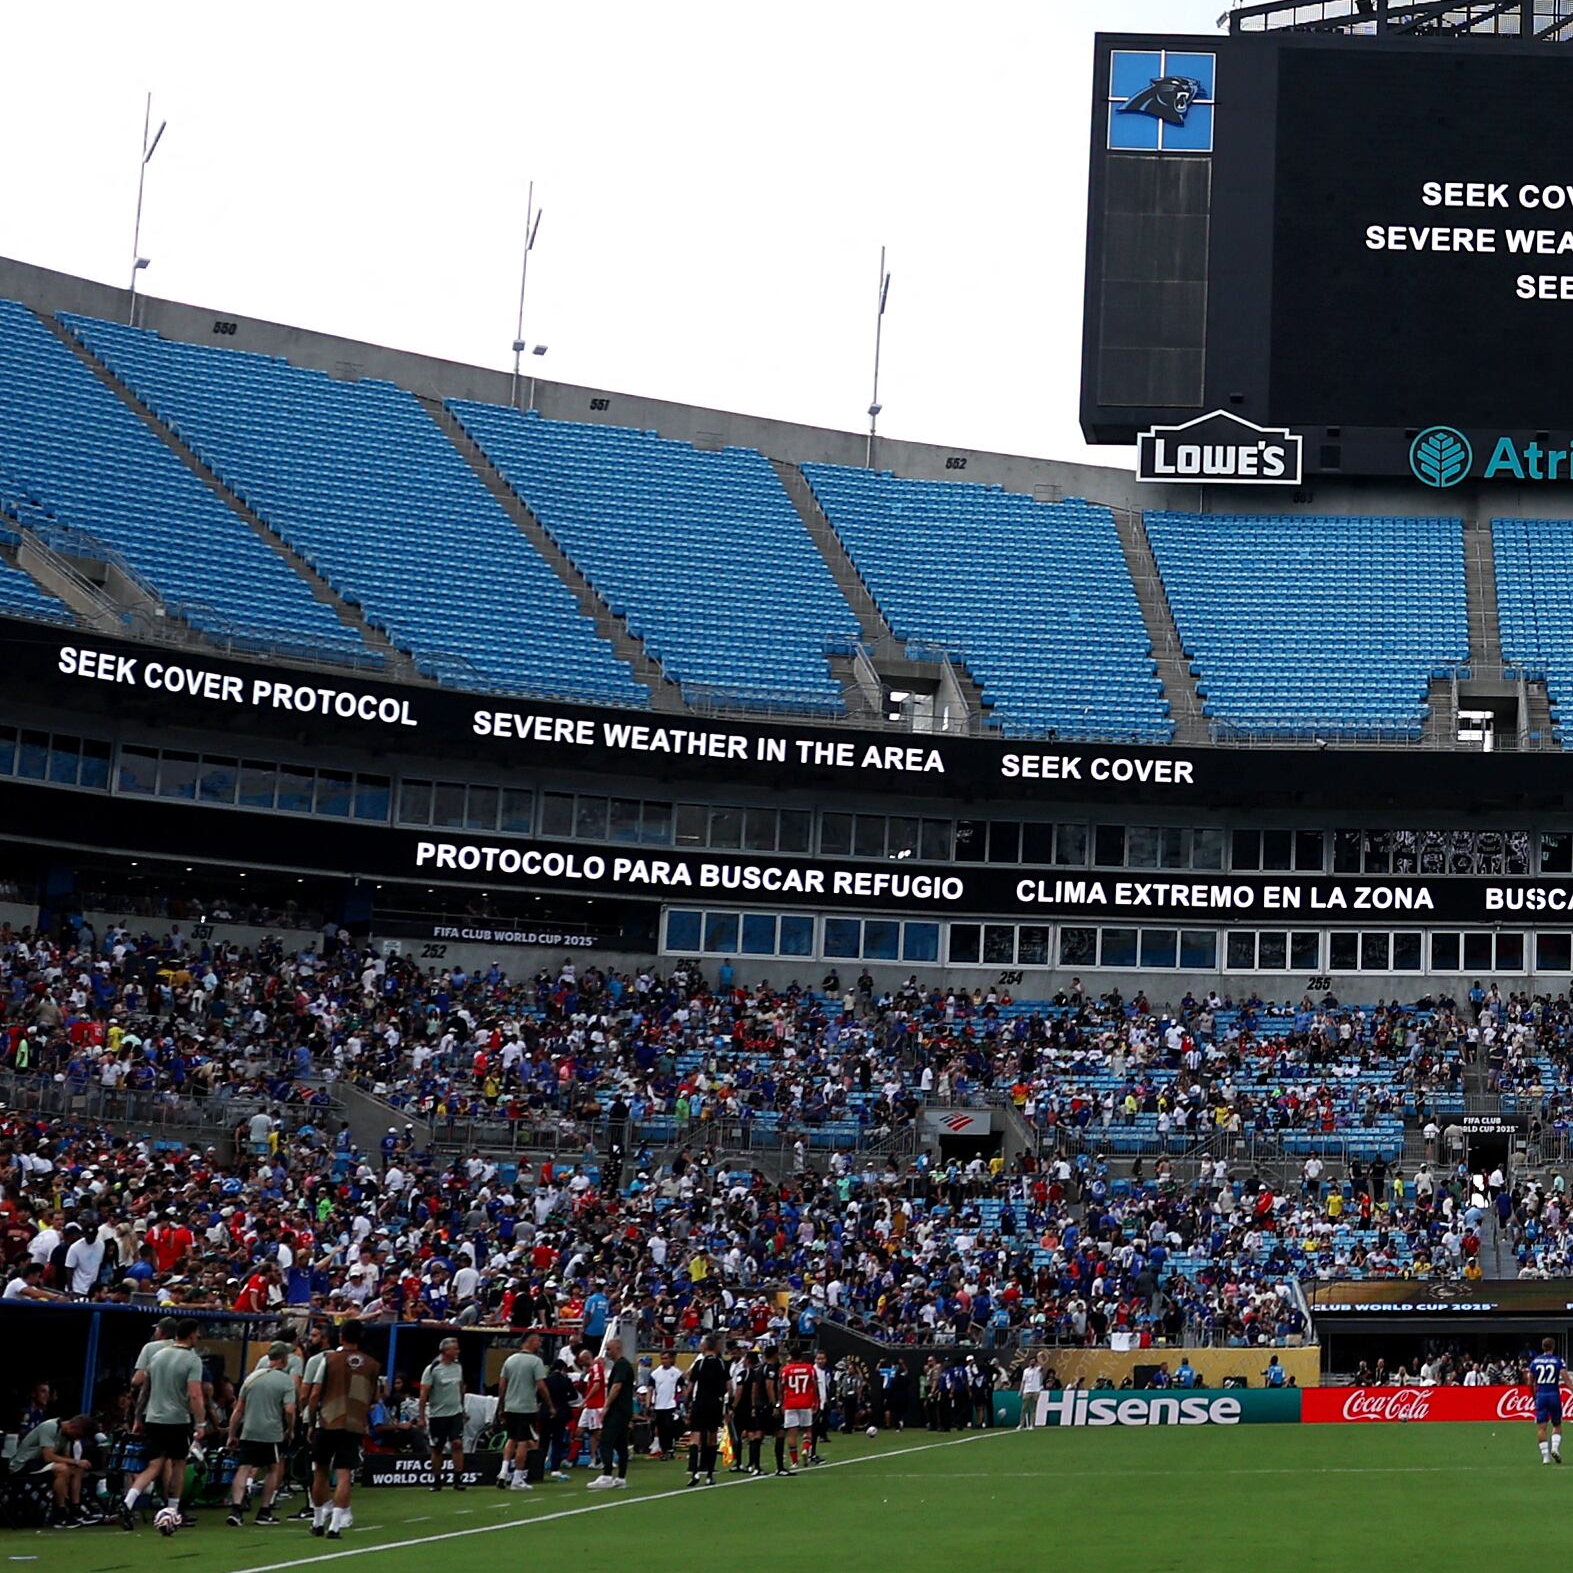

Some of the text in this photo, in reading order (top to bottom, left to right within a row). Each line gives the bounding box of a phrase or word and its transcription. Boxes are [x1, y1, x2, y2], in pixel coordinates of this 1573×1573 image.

[1422, 181, 1509, 208] SEEK
[1365, 225, 1496, 253] SEVERE
[589, 398, 611, 412] 551
[945, 457, 968, 470] 552
[1154, 438, 1285, 477] LOWE'S
[58, 646, 418, 726] SEEK COVER PROTOCOL
[472, 710, 945, 773] SEVERE WEATHER IN THE AREA
[1001, 754, 1194, 784] SEEK COVER
[416, 842, 964, 900] PROTOCOLO PARA BUSCAR REFUGIO
[1016, 879, 1434, 909] CLIMA EXTREMO EN LA ZONA
[434, 926, 593, 946] FIFA CLUB WORLD CUP 2025
[420, 943, 448, 959] 252
[997, 970, 1024, 985] 254
[1306, 975, 1332, 991] 255
[1535, 1364, 1556, 1384] 22
[788, 1375, 809, 1394] 47
[1035, 1389, 1241, 1427] Hisense
[395, 1459, 422, 1471] FIFA
[373, 1472, 477, 1485] WORLD 225
